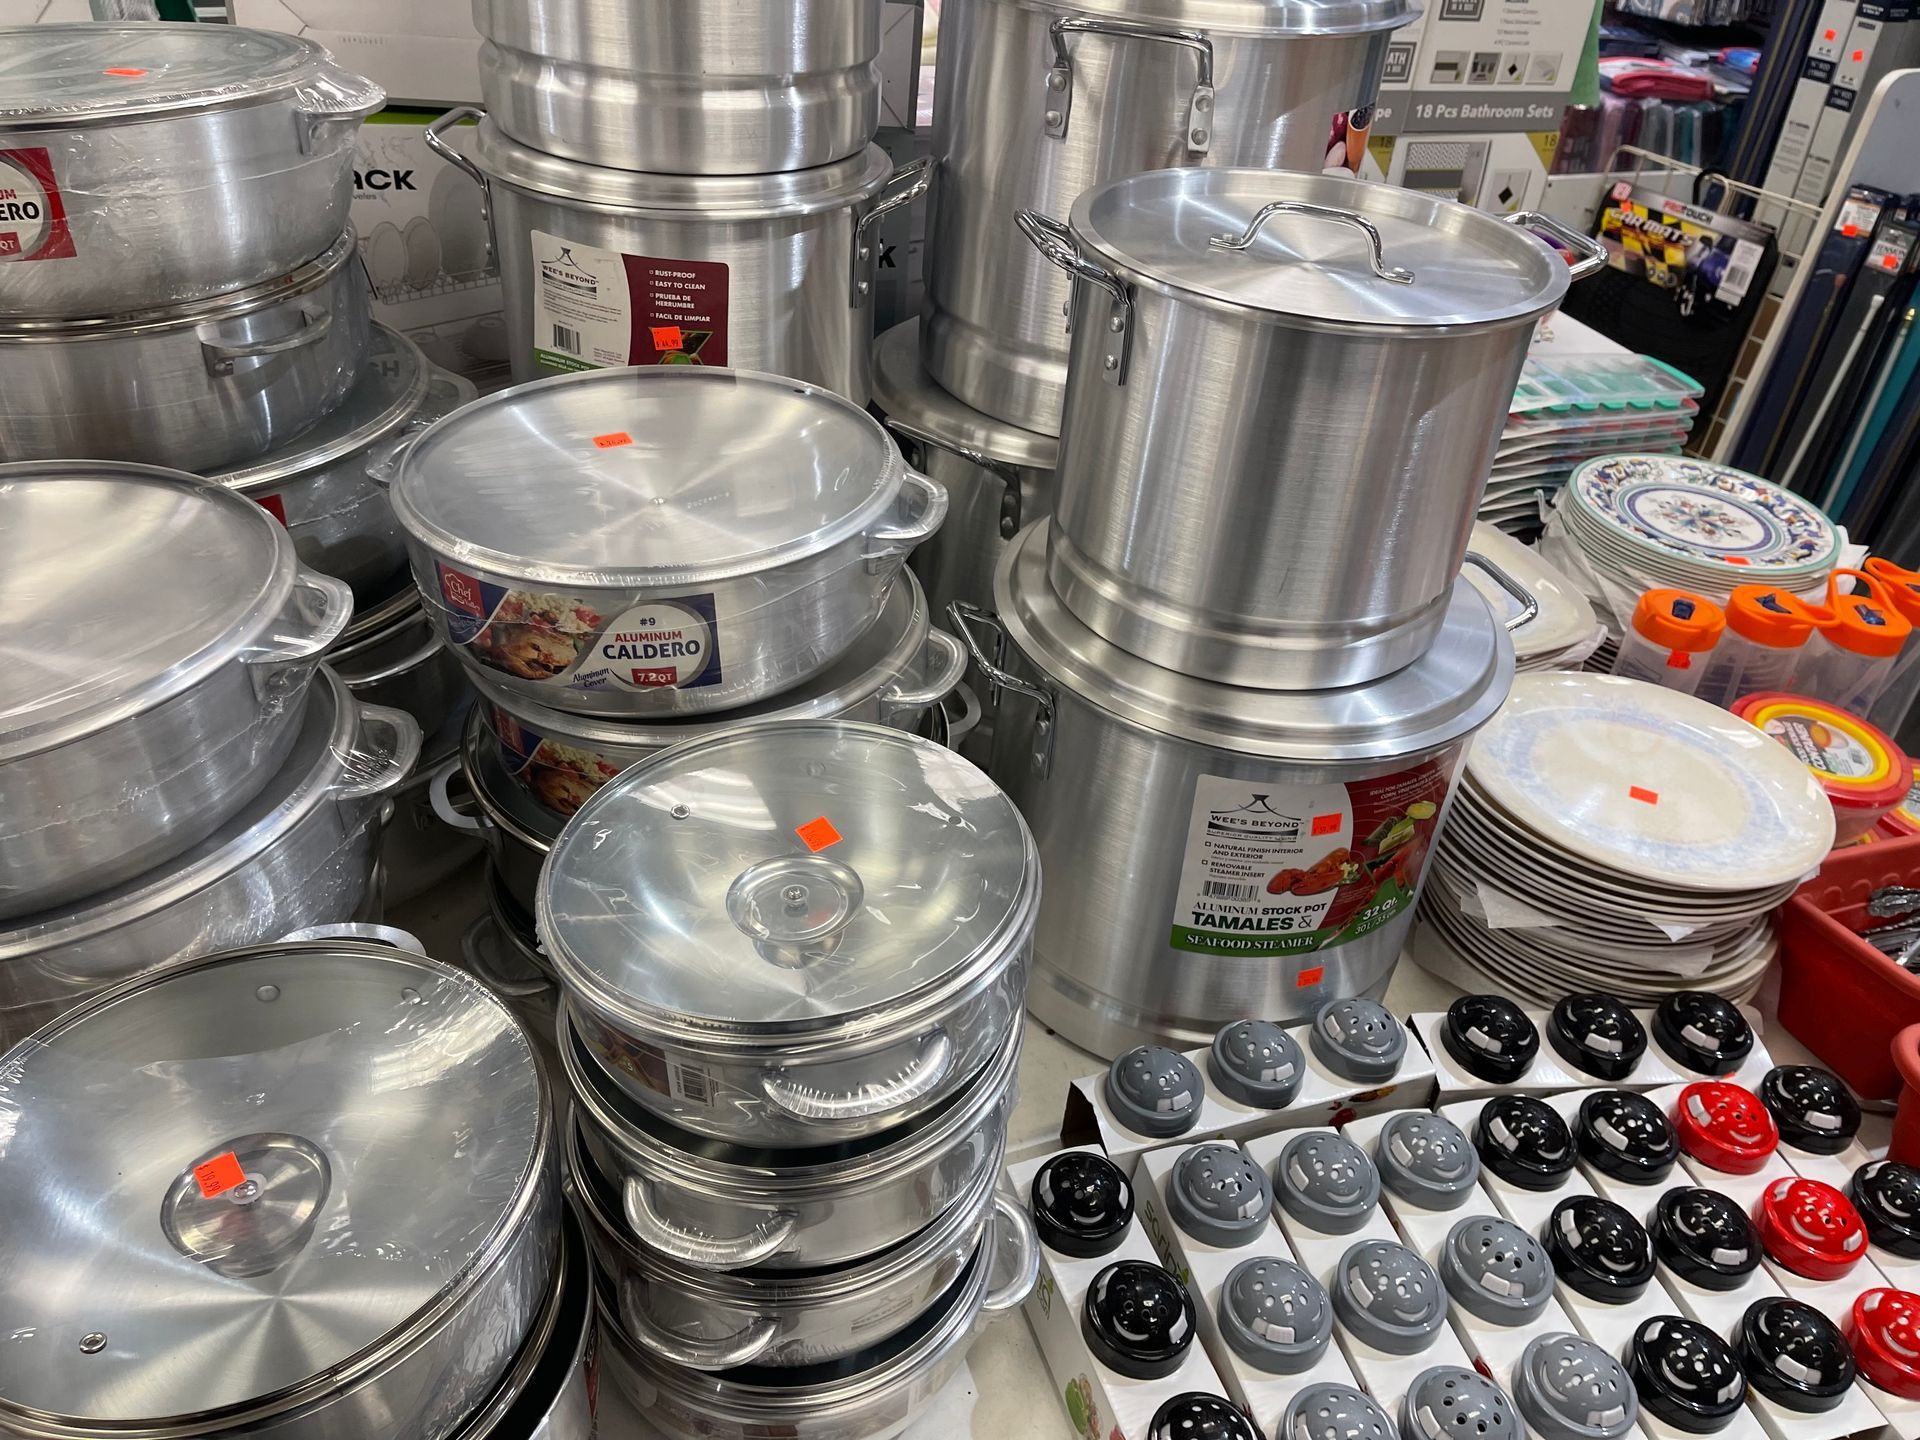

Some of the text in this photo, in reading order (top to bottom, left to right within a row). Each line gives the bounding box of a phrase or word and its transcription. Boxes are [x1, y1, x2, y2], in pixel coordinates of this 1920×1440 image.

[1416, 104, 1553, 118] 18 Pcs Bathroom Sets
[1544, 134, 1557, 147] 18
[655, 270, 696, 279] RUST-PROOF
[655, 293, 681, 301] PRUEBA
[655, 300, 695, 309] HERRUMBRE
[451, 581, 471, 600] Chef
[640, 617, 656, 626] #9
[615, 630, 682, 643] ALUMINUM
[603, 639, 700, 660] CALDERO
[572, 668, 610, 683] Aluminum
[584, 678, 607, 688] Cover
[1211, 814, 1248, 826] WEE'S
[1213, 843, 1246, 852] NATURAL
[1230, 852, 1264, 860] EXTERIOR
[1209, 867, 1241, 877] STEAMER
[1210, 861, 1252, 871] REMOVABLE
[1193, 901, 1328, 915] ALUMINUM STOCK POT
[1362, 906, 1379, 921] 32
[1191, 911, 1312, 931] TAMALES &
[1186, 934, 1314, 950] SEAFOOD STEAMER
